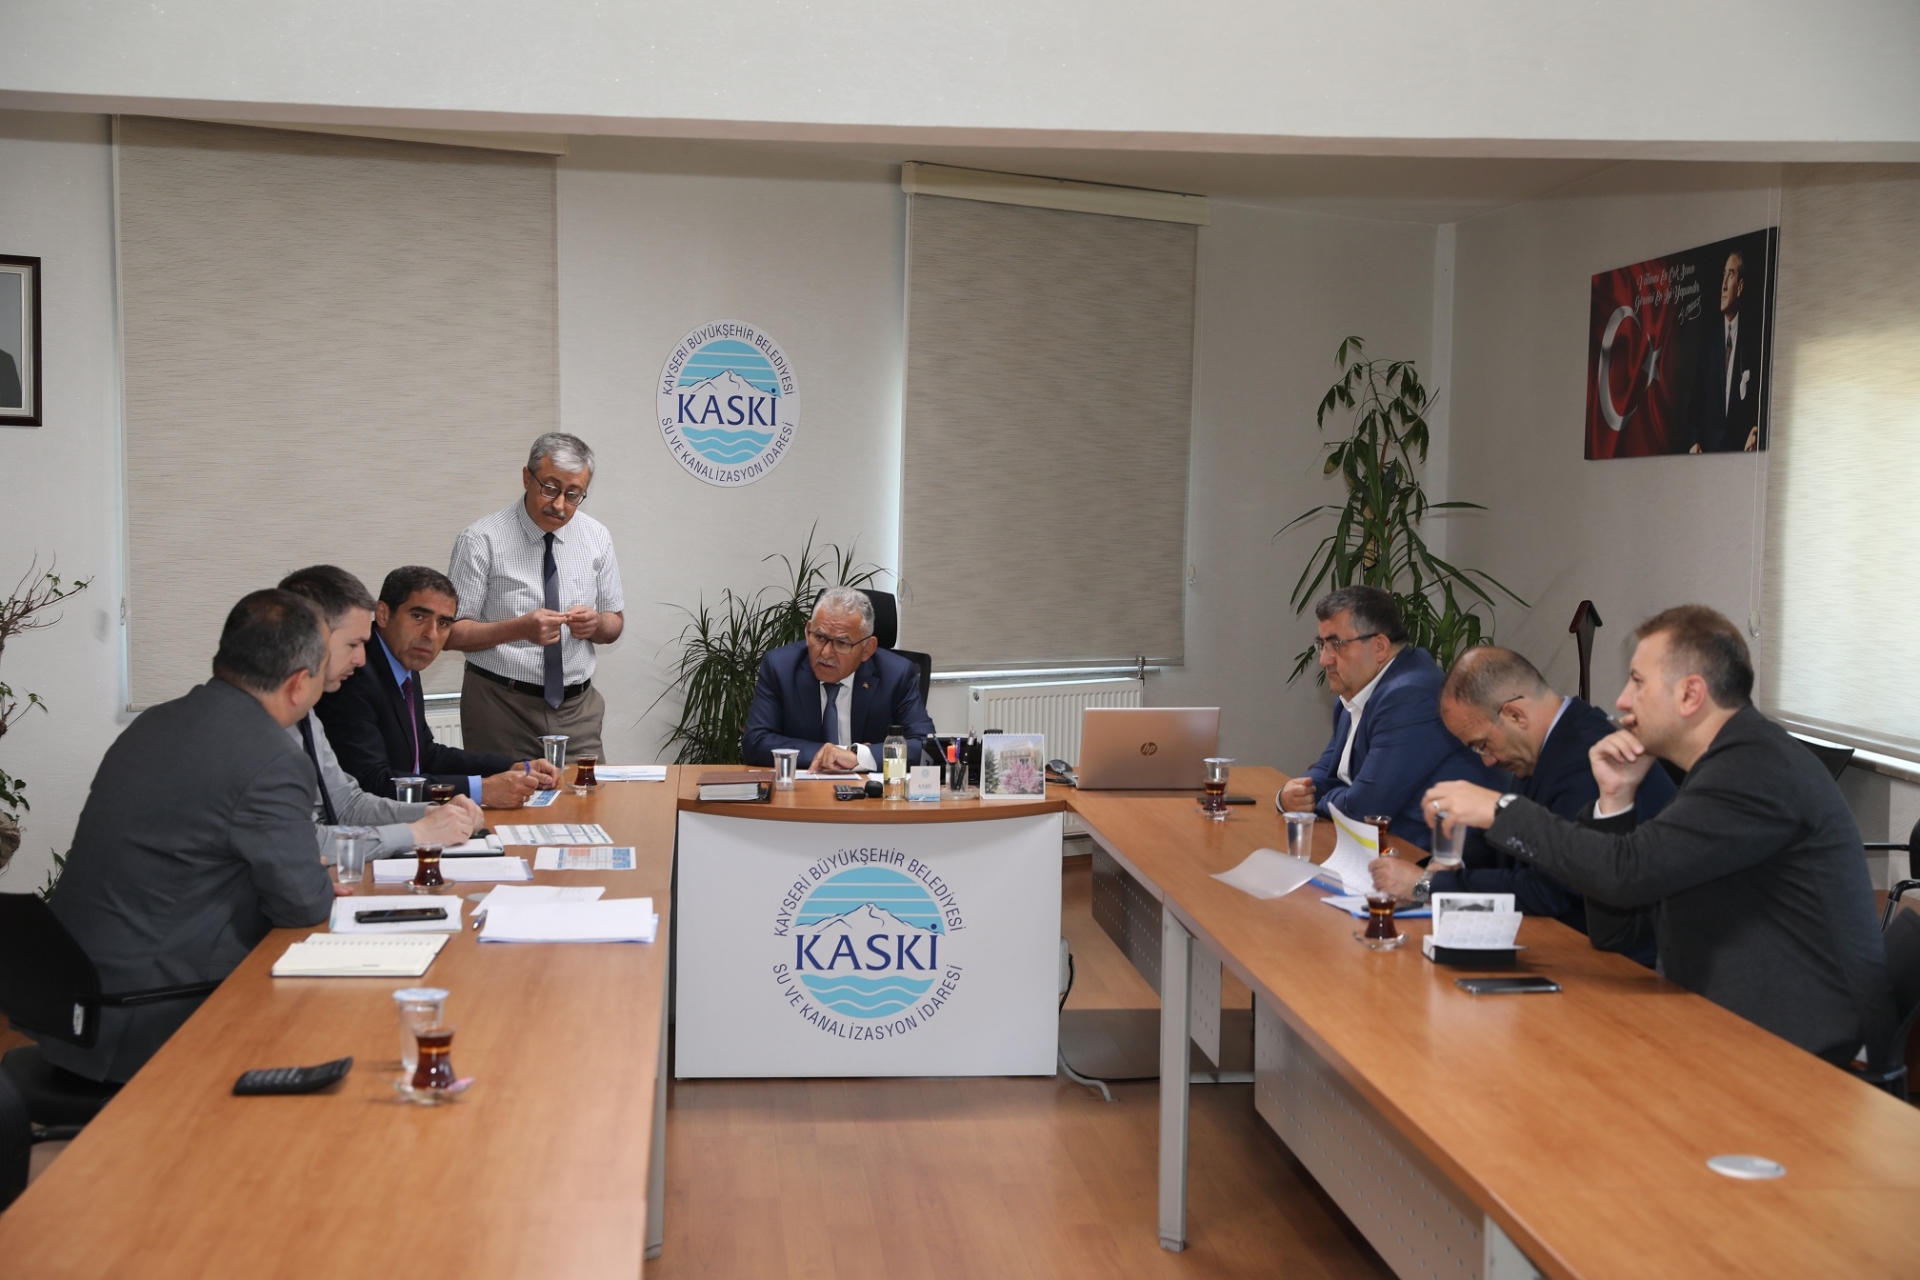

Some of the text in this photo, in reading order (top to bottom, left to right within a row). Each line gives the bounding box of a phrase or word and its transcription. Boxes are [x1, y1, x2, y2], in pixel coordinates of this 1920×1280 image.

[663, 323, 796, 396] KAYSERİ BÜYÜKŞEHİR BELEDİYESİ
[661, 417, 794, 483] SU VE KANALİZASYON İDARESİ
[774, 847, 967, 937] KAYSERİ BÜYÜKŞEHİR BELEDİYESİ
[773, 963, 963, 1041] SU VE KANALİZASYON İDARESİ
